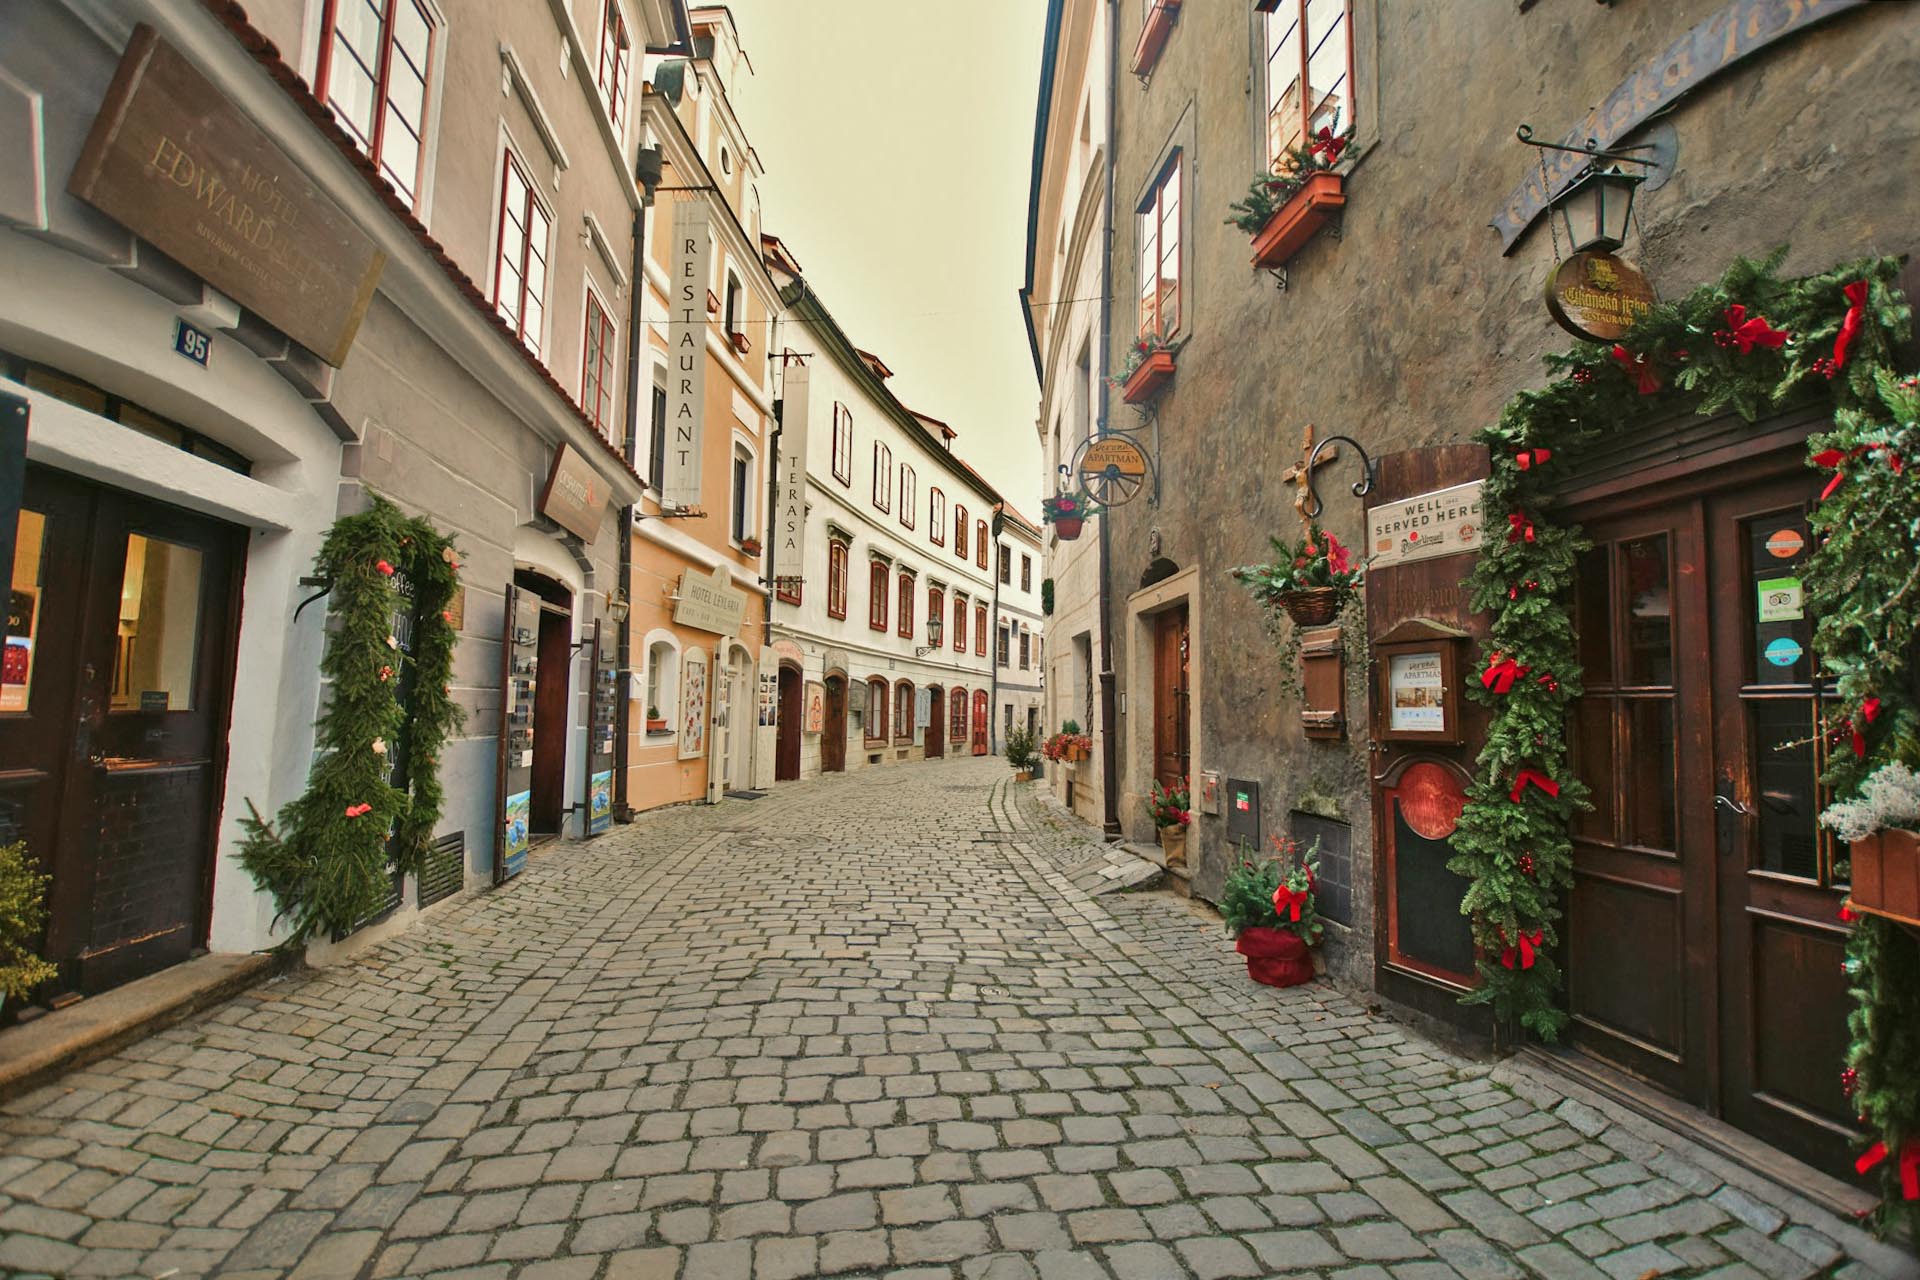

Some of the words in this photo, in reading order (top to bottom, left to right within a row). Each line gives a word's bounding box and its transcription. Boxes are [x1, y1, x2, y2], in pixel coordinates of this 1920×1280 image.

[151, 137, 274, 250] EDWARD
[183, 329, 207, 359] 95
[677, 239, 697, 466] RESTAURANT
[785, 456, 798, 549] TERASA
[1404, 499, 1443, 516] WELL
[1375, 515, 1430, 536] SERVED
[1436, 504, 1480, 522] HERE
[690, 585, 712, 605] HOTEL
